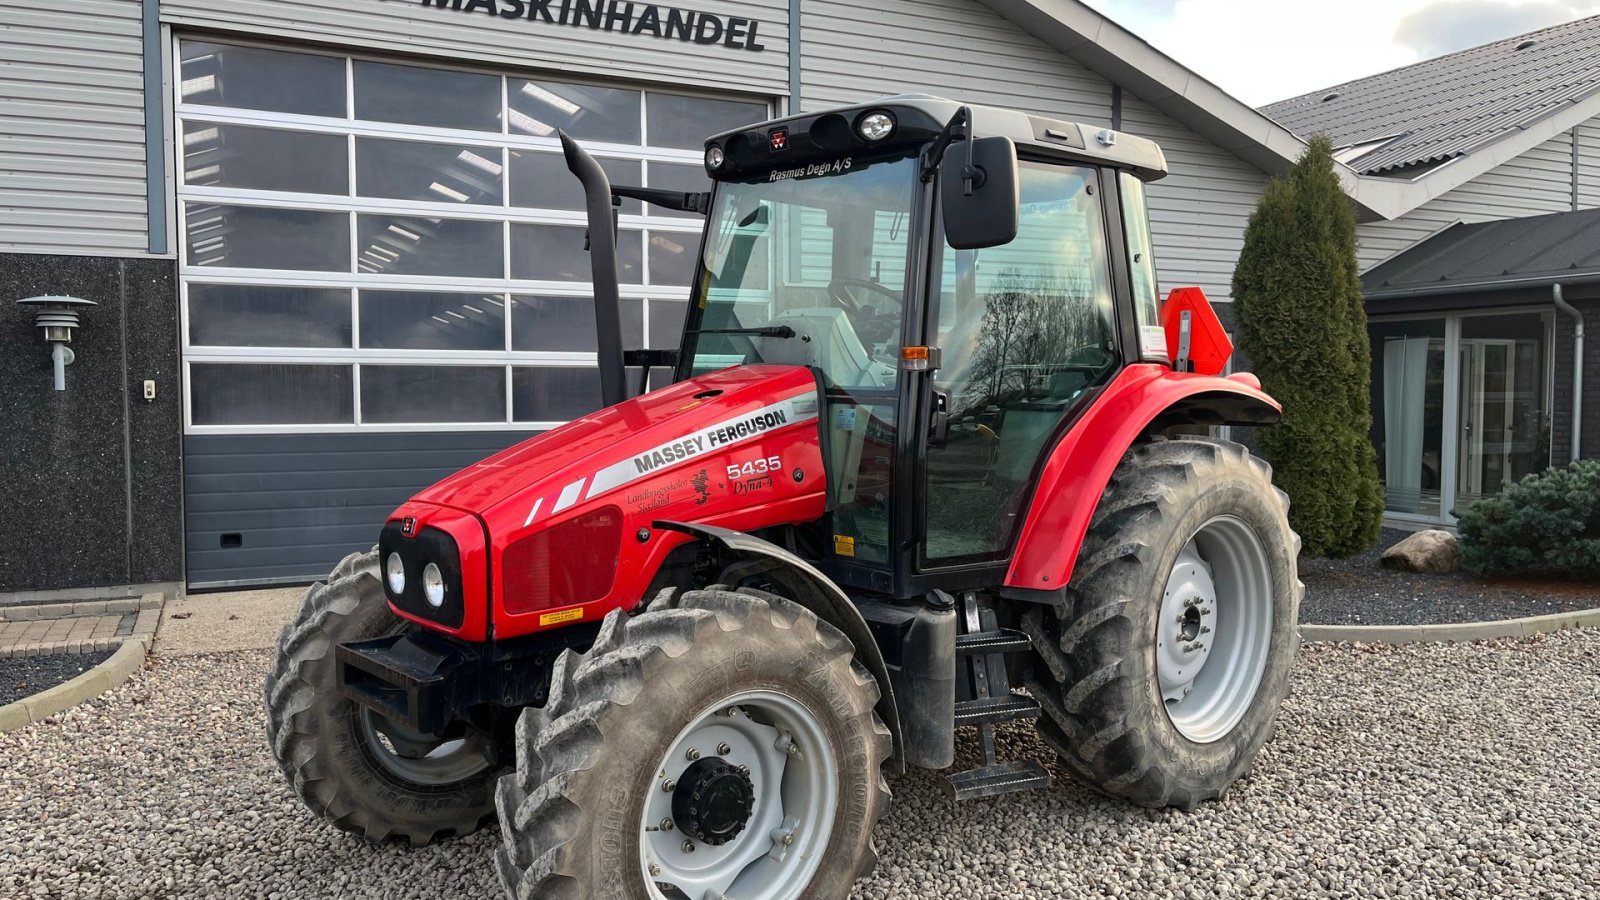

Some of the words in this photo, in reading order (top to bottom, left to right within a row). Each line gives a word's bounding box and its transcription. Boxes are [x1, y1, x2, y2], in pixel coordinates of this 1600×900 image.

[421, 0, 765, 52] SKINHANDEL
[769, 167, 805, 182] Rasmus
[806, 162, 831, 178] Degn
[832, 156, 852, 174] A/S
[634, 435, 705, 474] MASSEY
[709, 409, 788, 447] FERGUSON
[726, 455, 782, 480] 5435
